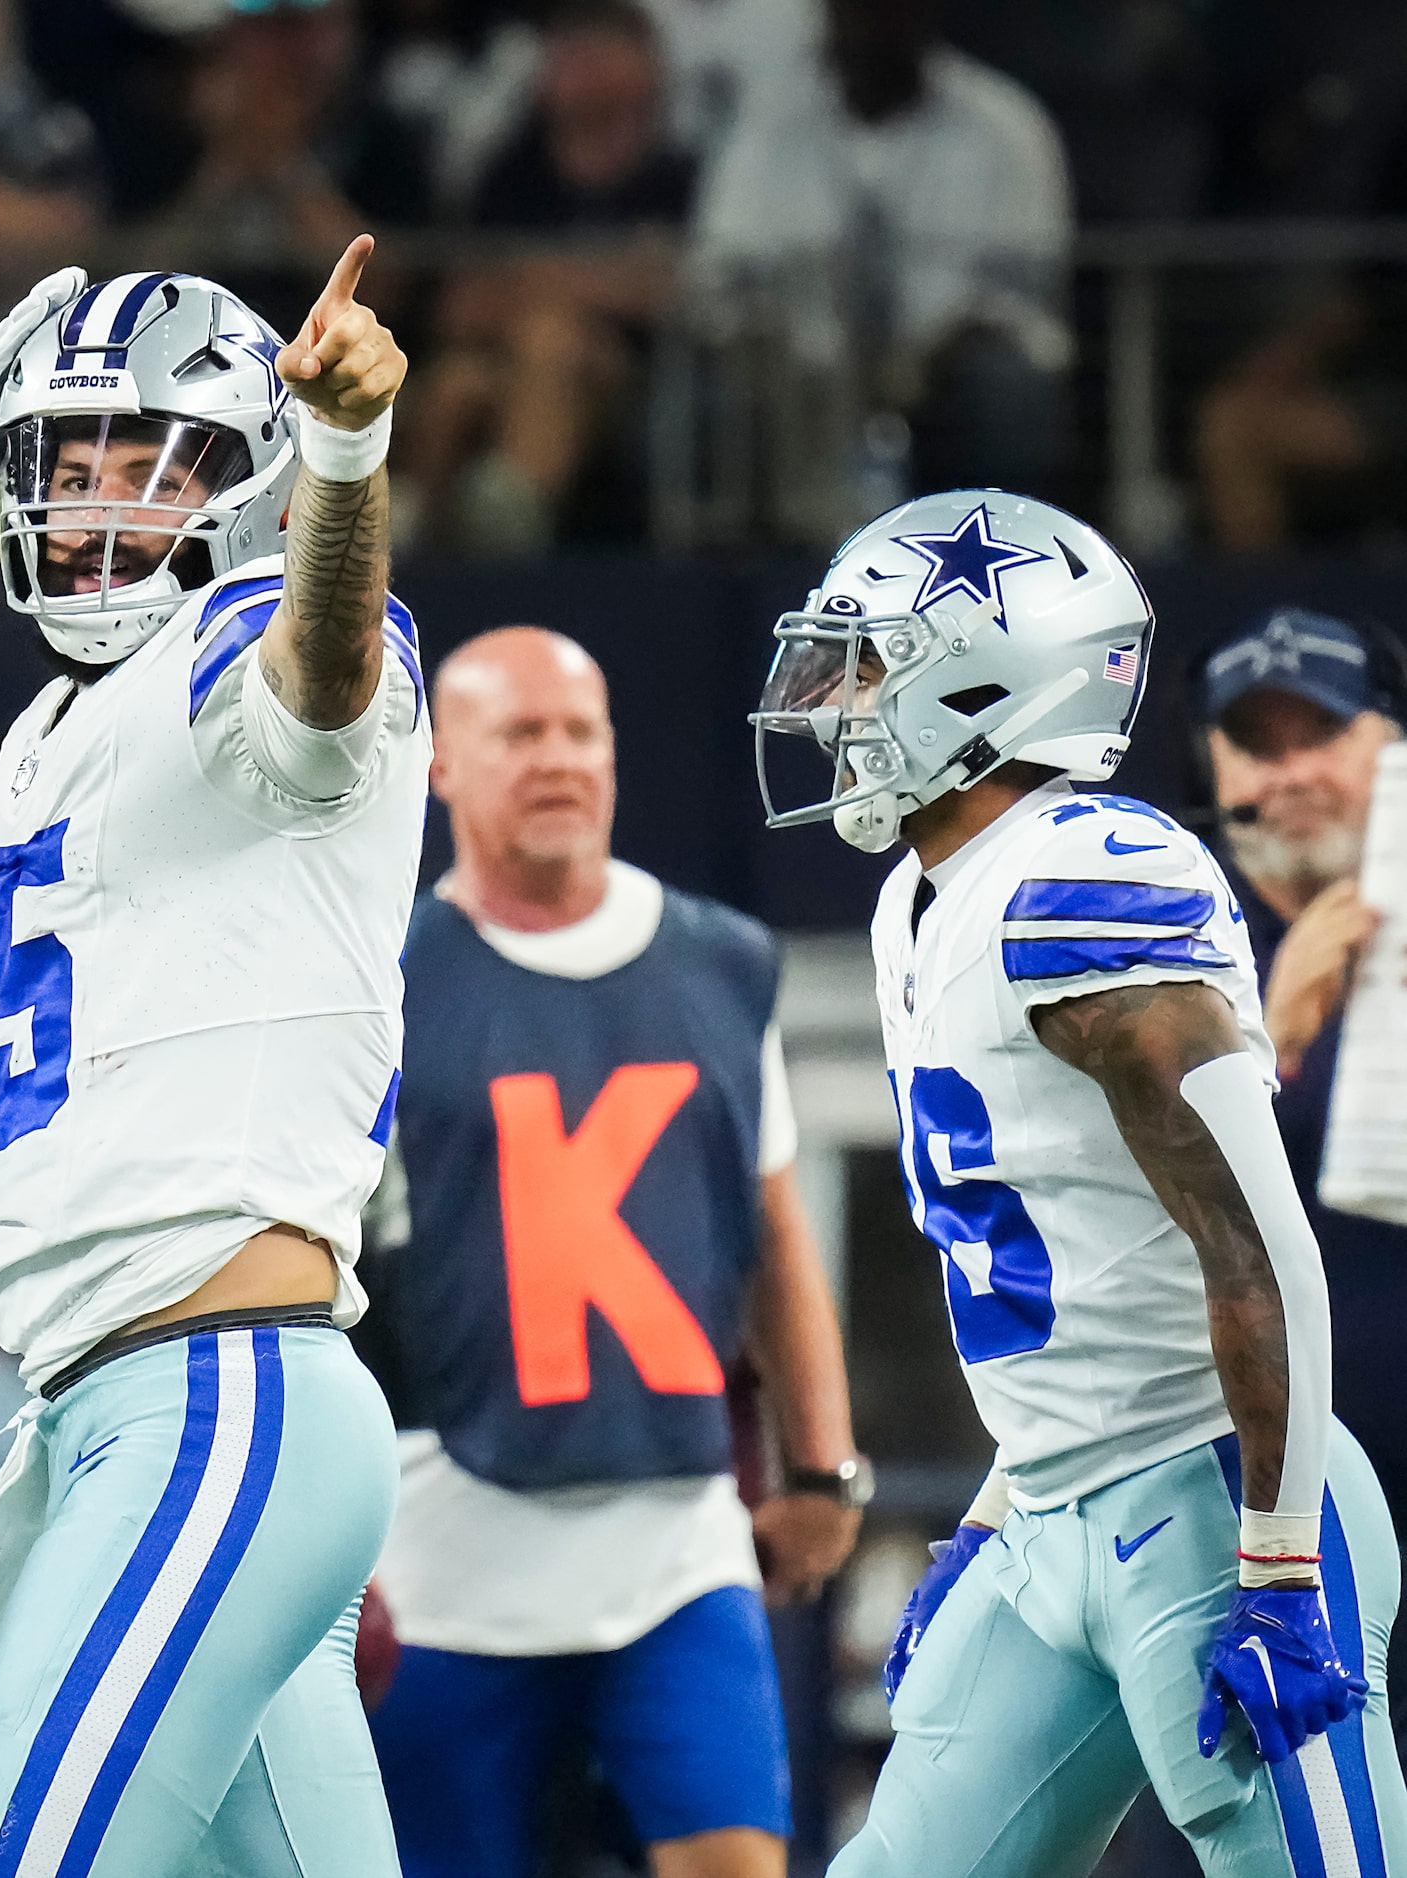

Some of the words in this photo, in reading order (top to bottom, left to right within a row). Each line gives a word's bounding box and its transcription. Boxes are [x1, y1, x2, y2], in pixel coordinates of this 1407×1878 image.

[49, 375, 118, 390] COWBOYS
[490, 1061, 725, 1408] K
[887, 1066, 1057, 1366] 6
